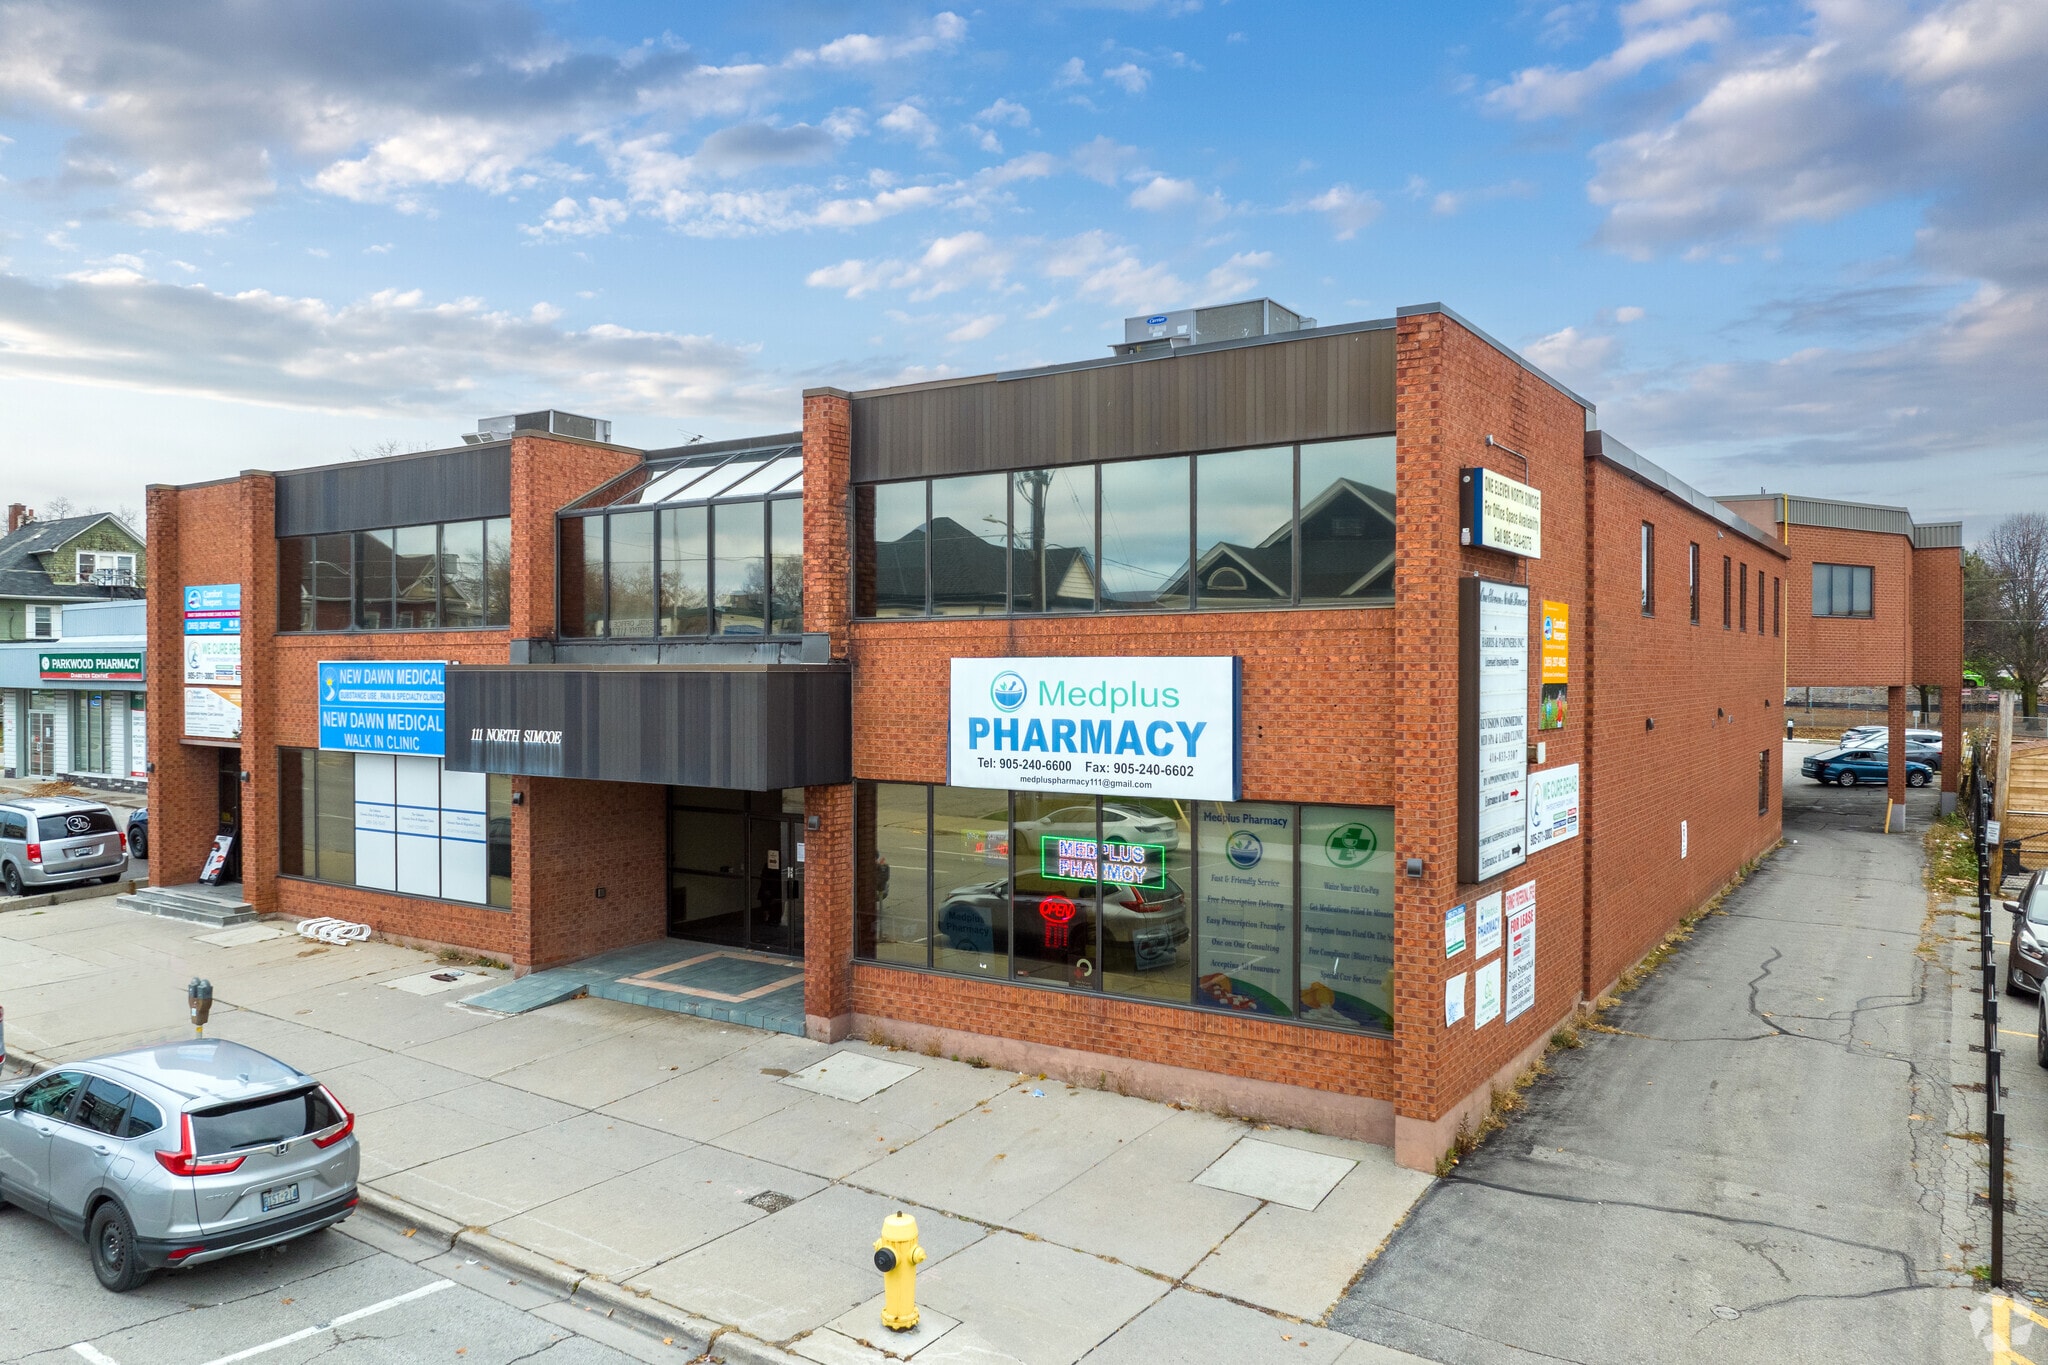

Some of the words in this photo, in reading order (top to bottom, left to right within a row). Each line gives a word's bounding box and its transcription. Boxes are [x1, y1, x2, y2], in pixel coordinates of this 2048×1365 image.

[1485, 476, 1494, 494] ONE
[1494, 480, 1510, 499] ELEVEN
[1511, 486, 1524, 504] NORTH
[1493, 502, 1505, 520] Office
[1506, 507, 1518, 526] Space
[1494, 526, 1502, 543] Call
[52, 658, 93, 669] PARKWOOD
[96, 658, 139, 669] PHARMACY
[340, 669, 362, 684] NEW
[364, 669, 394, 684] DAWN
[396, 669, 444, 685] MEDICAL
[340, 692, 366, 700] SUBSTANCE
[380, 692, 391, 700] PAIN
[423, 693, 444, 701] CLINICS
[1039, 680, 1180, 713] Medplus
[323, 711, 348, 728] NEW
[350, 712, 385, 730] DAWN
[388, 714, 443, 732] MEDICAL
[344, 733, 371, 748] WALK
[374, 735, 384, 748] IN
[387, 735, 420, 750] CLINIC
[471, 728, 483, 741] 111
[486, 729, 520, 742] NORTH
[524, 730, 562, 744] SIMCOE
[968, 717, 1207, 758] PHARMACY
[977, 758, 996, 769] Tel:
[999, 758, 1072, 772] 905-240-6600
[1085, 761, 1110, 774] Fax:
[1114, 762, 1194, 777] 905-240-6602
[1020, 775, 1152, 789] medpluspharmacy111@gmail.com
[1551, 778, 1562, 798] CURE
[1485, 795, 1498, 807] Entrance
[1204, 812, 1240, 825] Medplus
[1242, 813, 1288, 828] Pharmacy
[1482, 856, 1497, 869] Entrance
[1211, 874, 1223, 882] Fast
[1230, 876, 1256, 886] Friendly
[1258, 878, 1280, 887] Service
[1340, 883, 1352, 891] Your
[1360, 885, 1379, 896] Co-Pay
[1042, 901, 1072, 917] OPEN
[1207, 895, 1219, 903] Free
[1221, 896, 1257, 907] Prescription
[1258, 900, 1284, 911] Delivery
[1310, 903, 1318, 911] Get
[1319, 904, 1350, 914] Medications
[1350, 906, 1365, 915] Filled
[1206, 916, 1220, 926] Easy
[1222, 917, 1258, 929] Prescription
[1260, 922, 1285, 932] Transfer
[1478, 916, 1500, 940] PHARMACY
[1510, 917, 1519, 934] FOR
[1520, 910, 1533, 928] LEASE
[1305, 924, 1335, 936] Prescription
[1352, 929, 1366, 938] Fixed
[1367, 931, 1375, 939] On
[1376, 932, 1387, 940] The
[1212, 938, 1223, 946] One
[1233, 940, 1245, 948] One
[1247, 942, 1280, 954] Consulting
[1309, 946, 1319, 955] Free
[1320, 948, 1350, 959] Compliance
[1351, 951, 1372, 962] (Blister)
[1250, 964, 1280, 974] Insurance
[1320, 970, 1339, 980] Special
[1340, 972, 1352, 981] Care
[1353, 974, 1362, 982] For
[1363, 976, 1381, 985] Seniors
